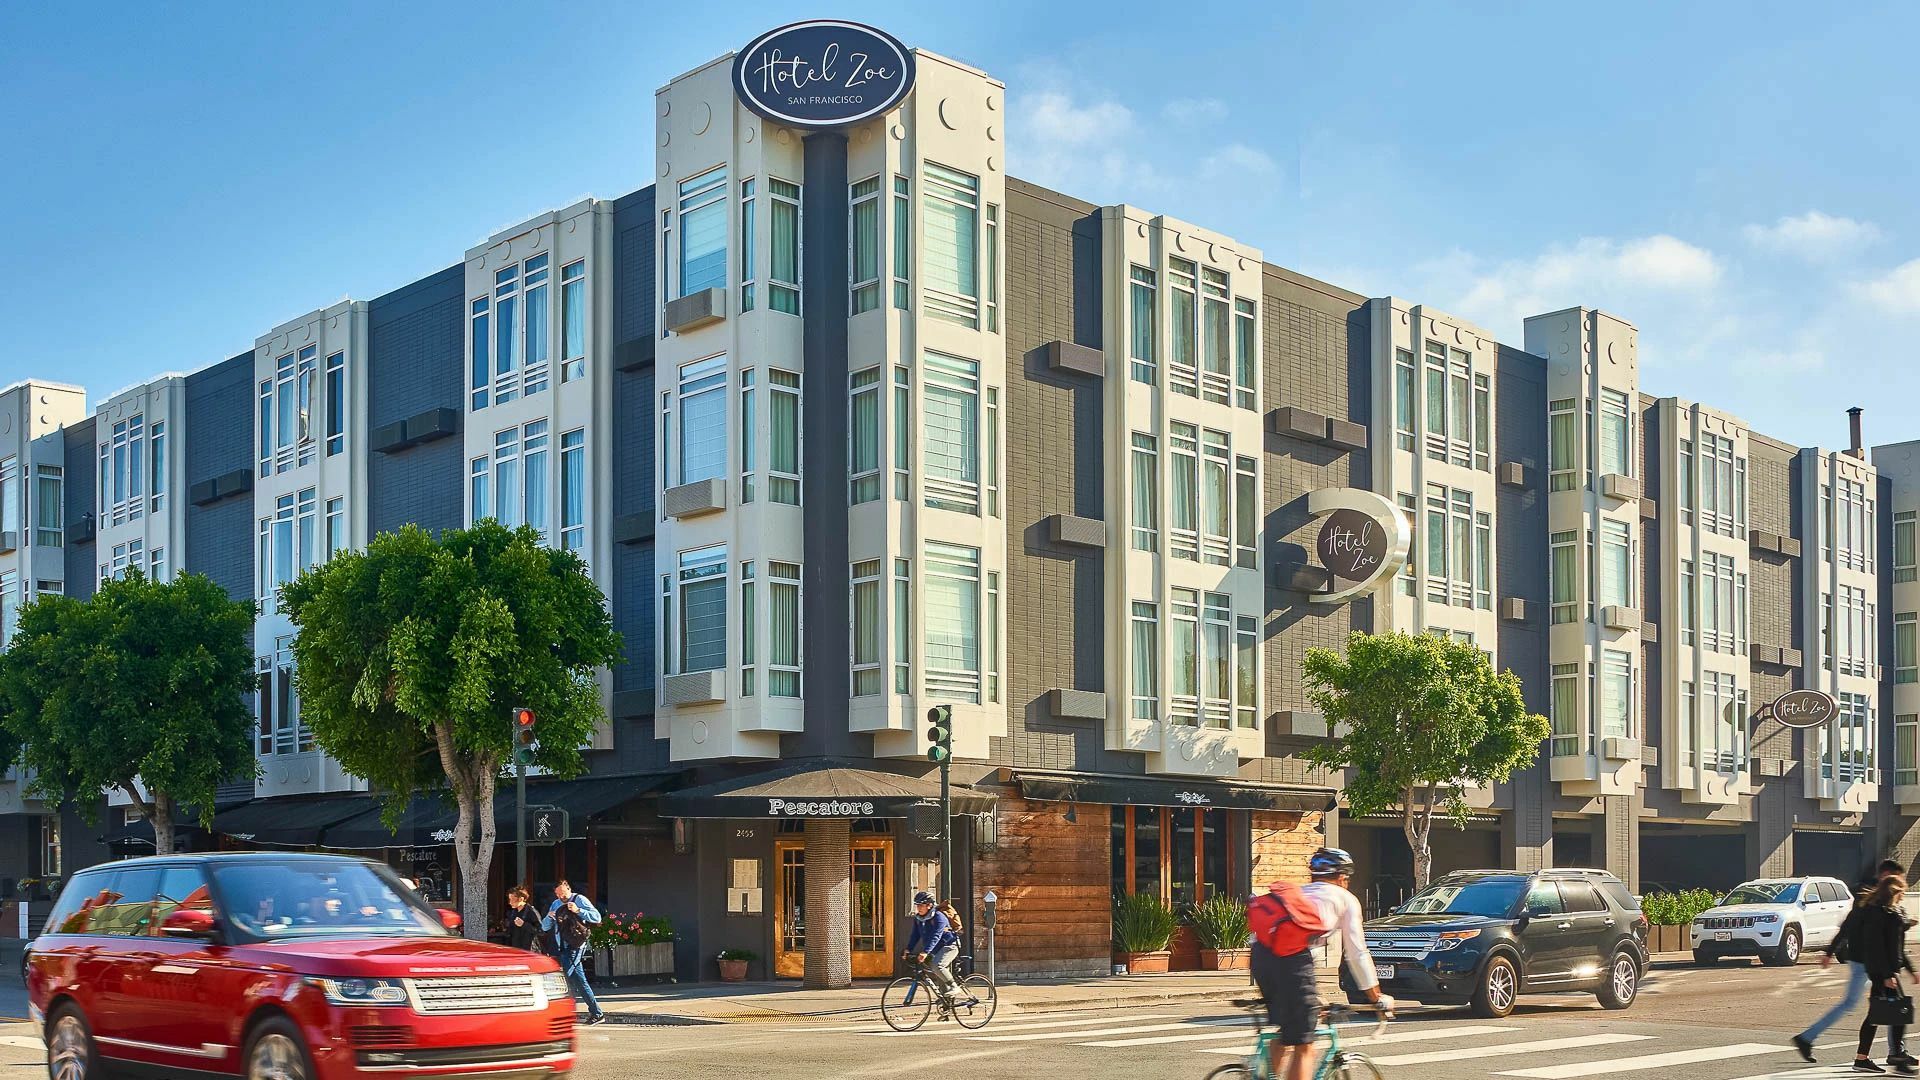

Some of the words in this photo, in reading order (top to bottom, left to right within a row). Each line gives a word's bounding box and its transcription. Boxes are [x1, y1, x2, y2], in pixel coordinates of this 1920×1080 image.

[754, 42, 840, 94] Hotel
[845, 53, 896, 88] Zoe
[787, 96, 807, 105] SAN
[809, 95, 863, 104] FRANCISCO
[1324, 520, 1372, 556] Hotel
[1350, 547, 1379, 572] Zoe
[1779, 697, 1809, 717] Hotel
[1809, 700, 1827, 714] Zoe
[768, 798, 874, 816] Pescatore
